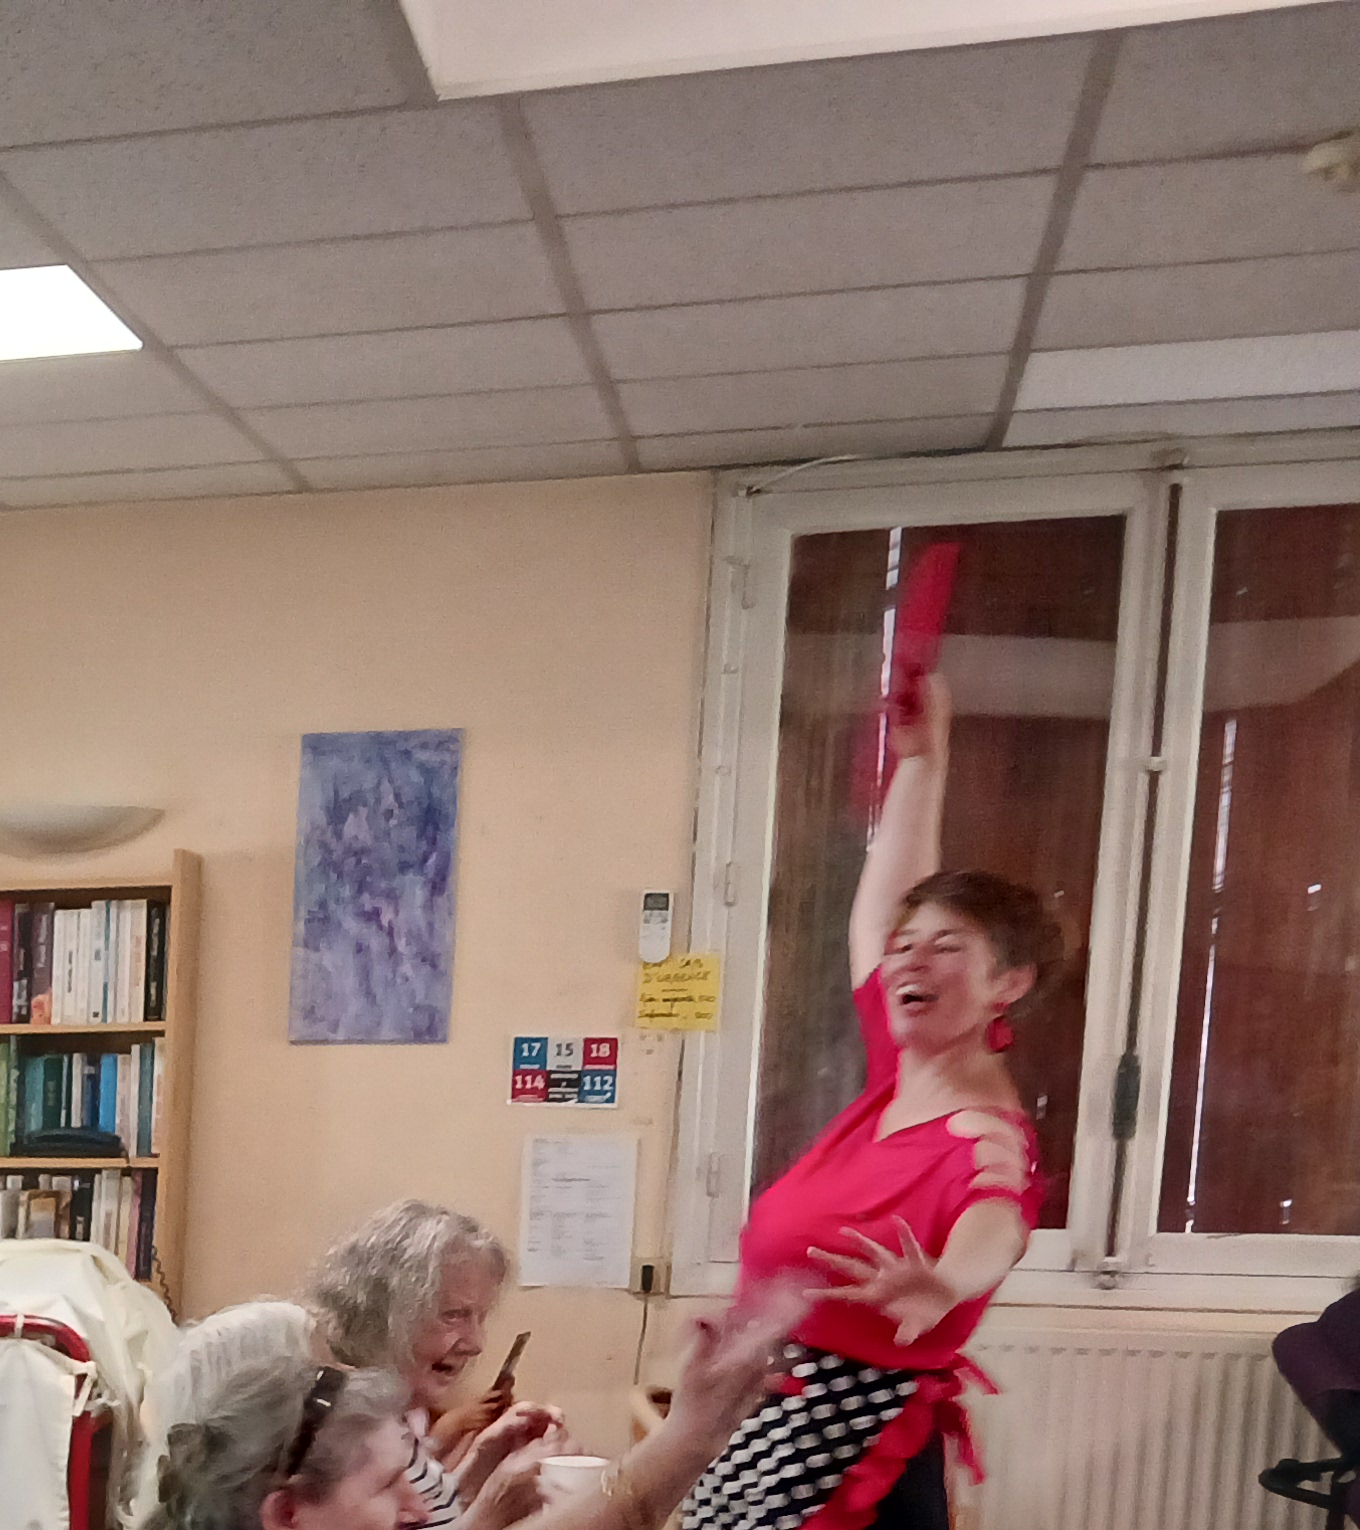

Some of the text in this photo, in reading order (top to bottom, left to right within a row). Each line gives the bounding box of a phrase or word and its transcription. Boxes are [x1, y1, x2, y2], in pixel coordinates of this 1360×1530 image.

[521, 1042, 542, 1057] 17
[555, 1042, 575, 1057] 15
[590, 1042, 611, 1058] 18
[515, 1074, 546, 1090] 114
[582, 1075, 614, 1091] 112
